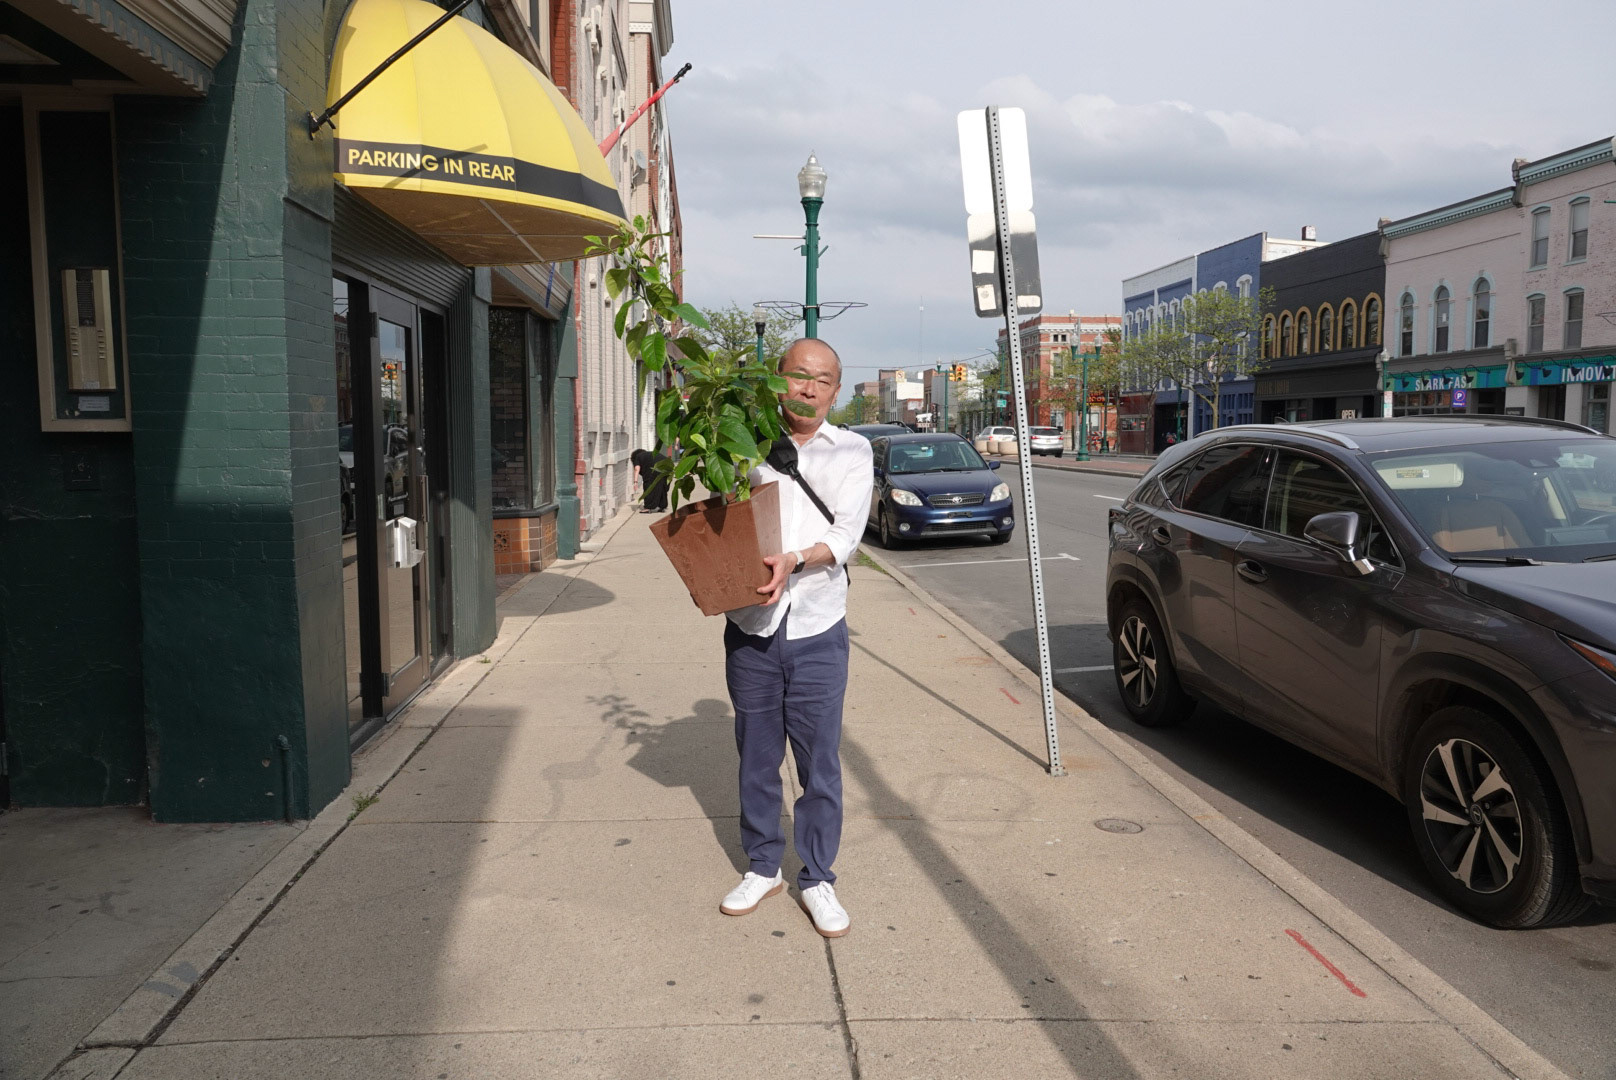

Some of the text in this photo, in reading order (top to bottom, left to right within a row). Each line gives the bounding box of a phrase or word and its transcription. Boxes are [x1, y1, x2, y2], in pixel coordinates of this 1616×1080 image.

[348, 148, 516, 183] PARKING IN REAR
[1341, 409, 1356, 420] OPEN
